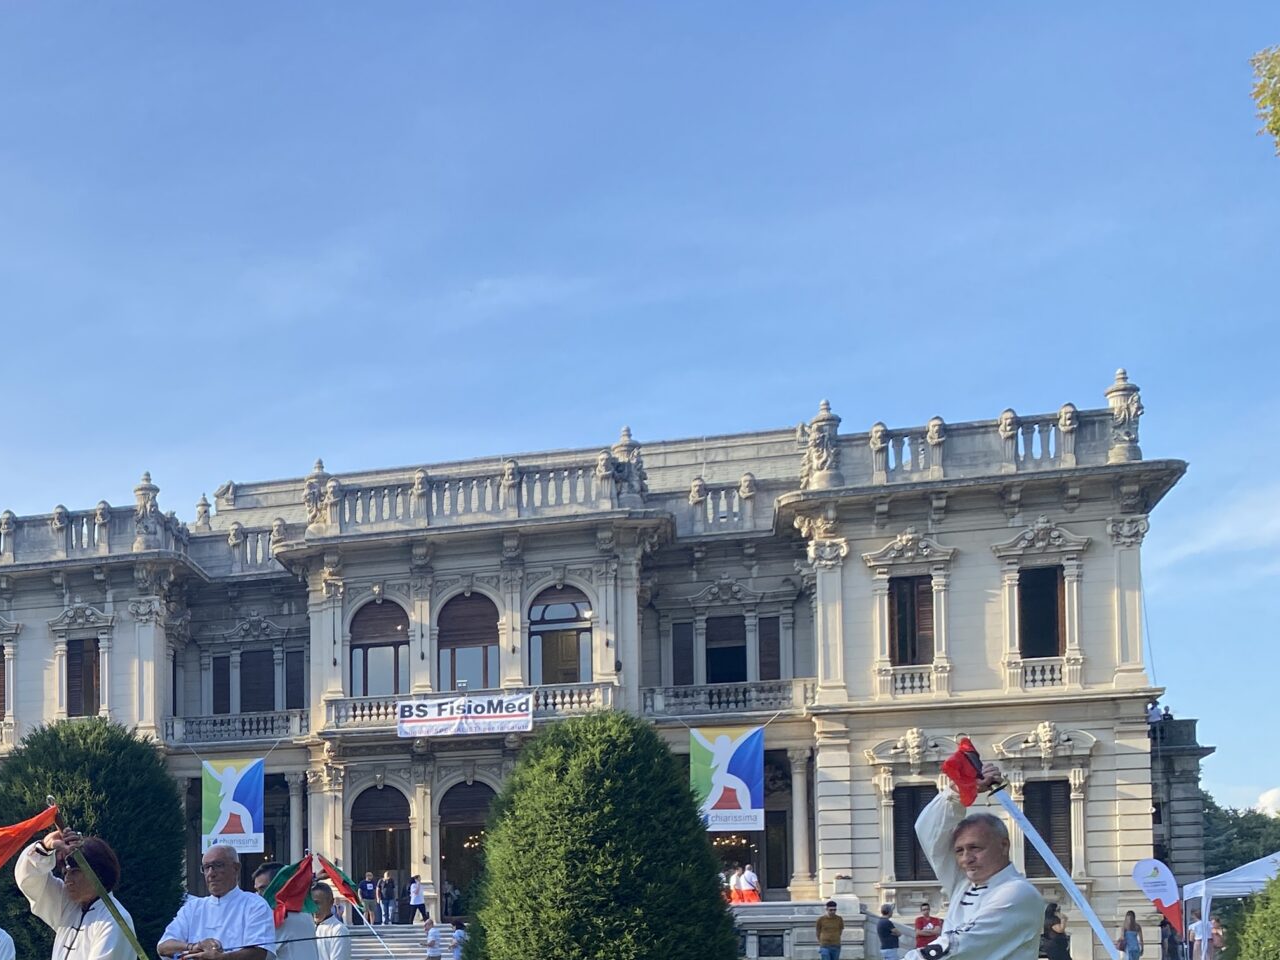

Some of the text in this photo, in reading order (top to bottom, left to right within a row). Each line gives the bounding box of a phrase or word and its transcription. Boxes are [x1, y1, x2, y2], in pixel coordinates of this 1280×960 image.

[400, 698, 529, 718] BS FisioMed
[711, 814, 757, 822] chiarissima
